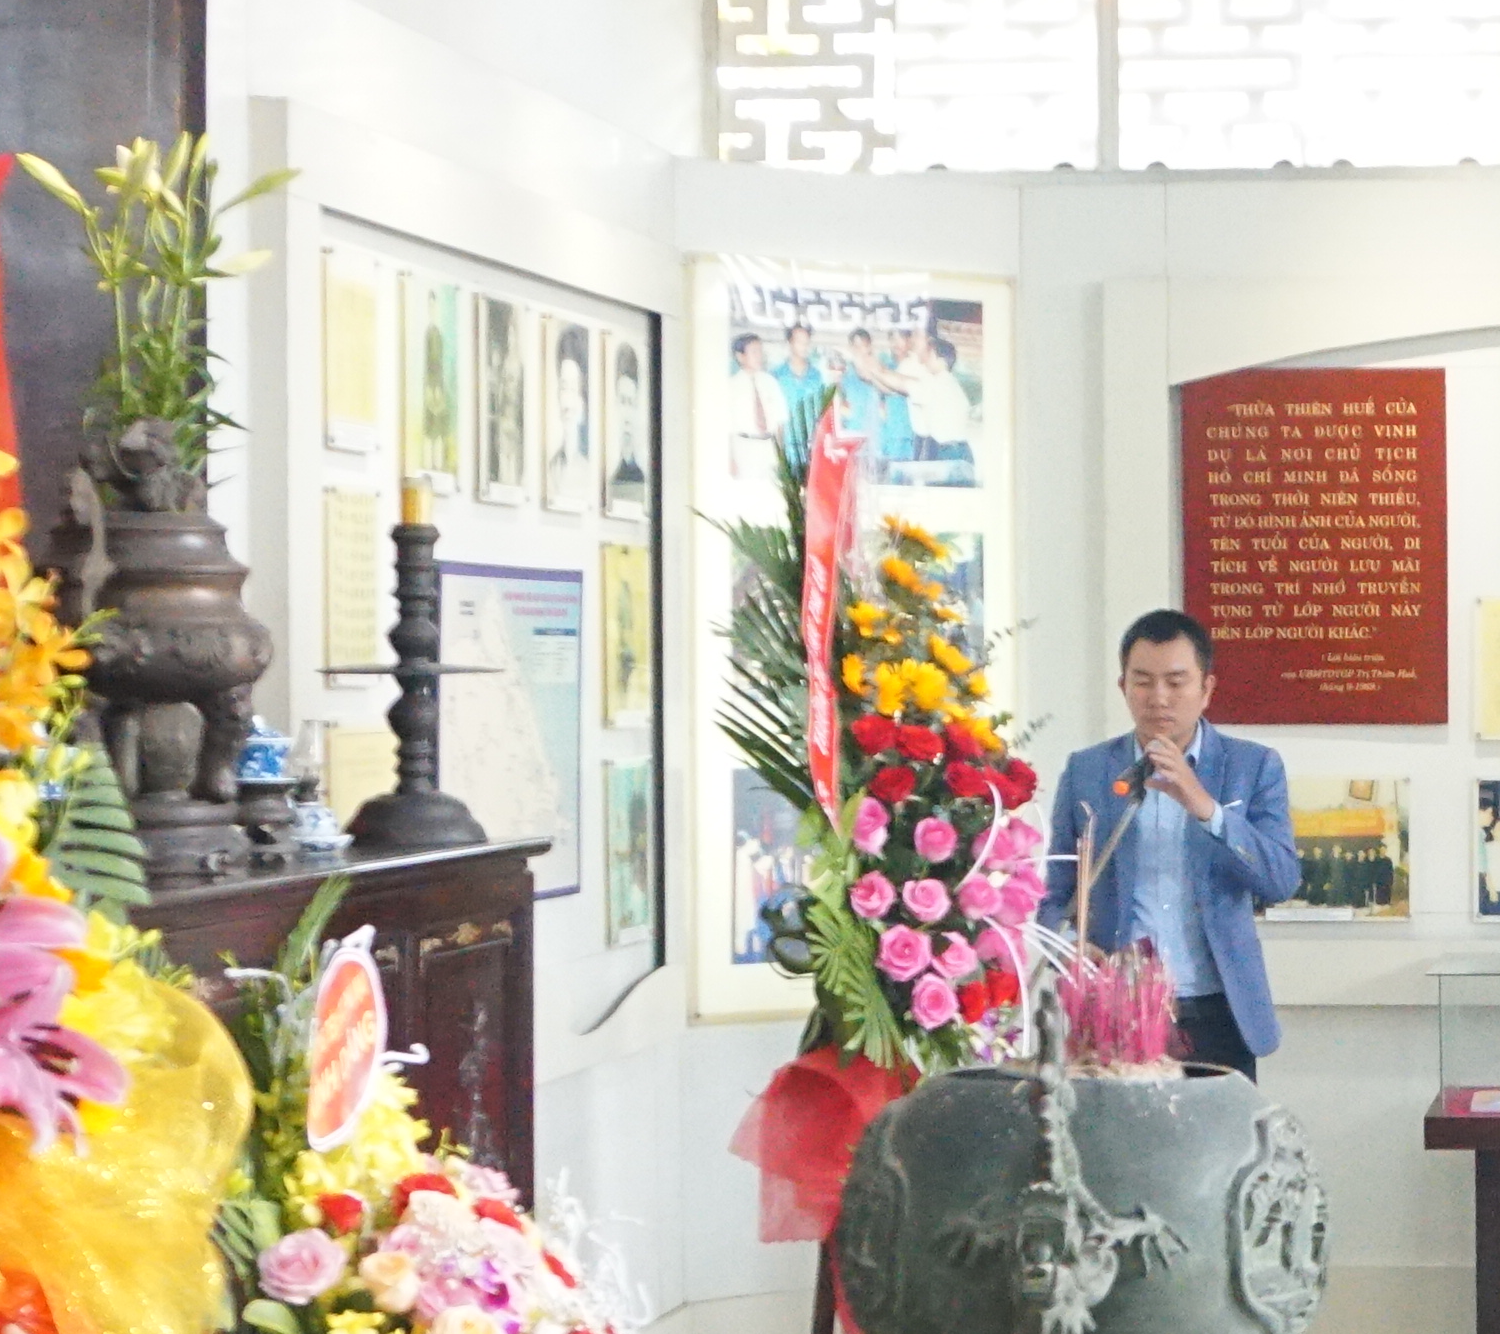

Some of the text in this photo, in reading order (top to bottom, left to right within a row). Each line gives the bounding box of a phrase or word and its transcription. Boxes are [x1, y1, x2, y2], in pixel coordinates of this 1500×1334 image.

[1285, 401, 1332, 416] THIÊN
[1343, 396, 1375, 416] HUẾ
[1386, 397, 1417, 415] CỦA
[1206, 423, 1417, 441] CHÚNG TA ĐƯỢC VINH
[1207, 443, 1417, 464] DỰ LÀ NƠI CHỦ TỊCH
[1208, 463, 1417, 484] HỒ CHÍ MINH ĐÃ SỐNG
[1210, 493, 1261, 507] TRONG
[1272, 490, 1310, 507] THỜI
[1320, 490, 1358, 507] NIÊN
[1210, 513, 1231, 528] TỪ
[1234, 513, 1255, 528] ĐÓ
[1258, 514, 1297, 528] HÌNH
[1301, 510, 1332, 528] ẢNH
[1334, 510, 1366, 528] CỦA
[1210, 535, 1241, 551] TÊN
[1252, 531, 1287, 550] TUỔI
[1299, 533, 1330, 550] CỦA
[1404, 537, 1421, 550] DI
[1210, 555, 1421, 573] TÍCH VỀ NGƯỜI LƯU MÃI
[1210, 576, 1421, 595] TRONG TRÍ NHỚ TRUYỀN
[1210, 600, 1422, 619] TỤNG TỪ LỚP NGƯỜI NÀY
[1210, 622, 1241, 640] ĐẾN
[1245, 622, 1274, 639] LỚP
[1276, 622, 1324, 639] NGƯỜI
